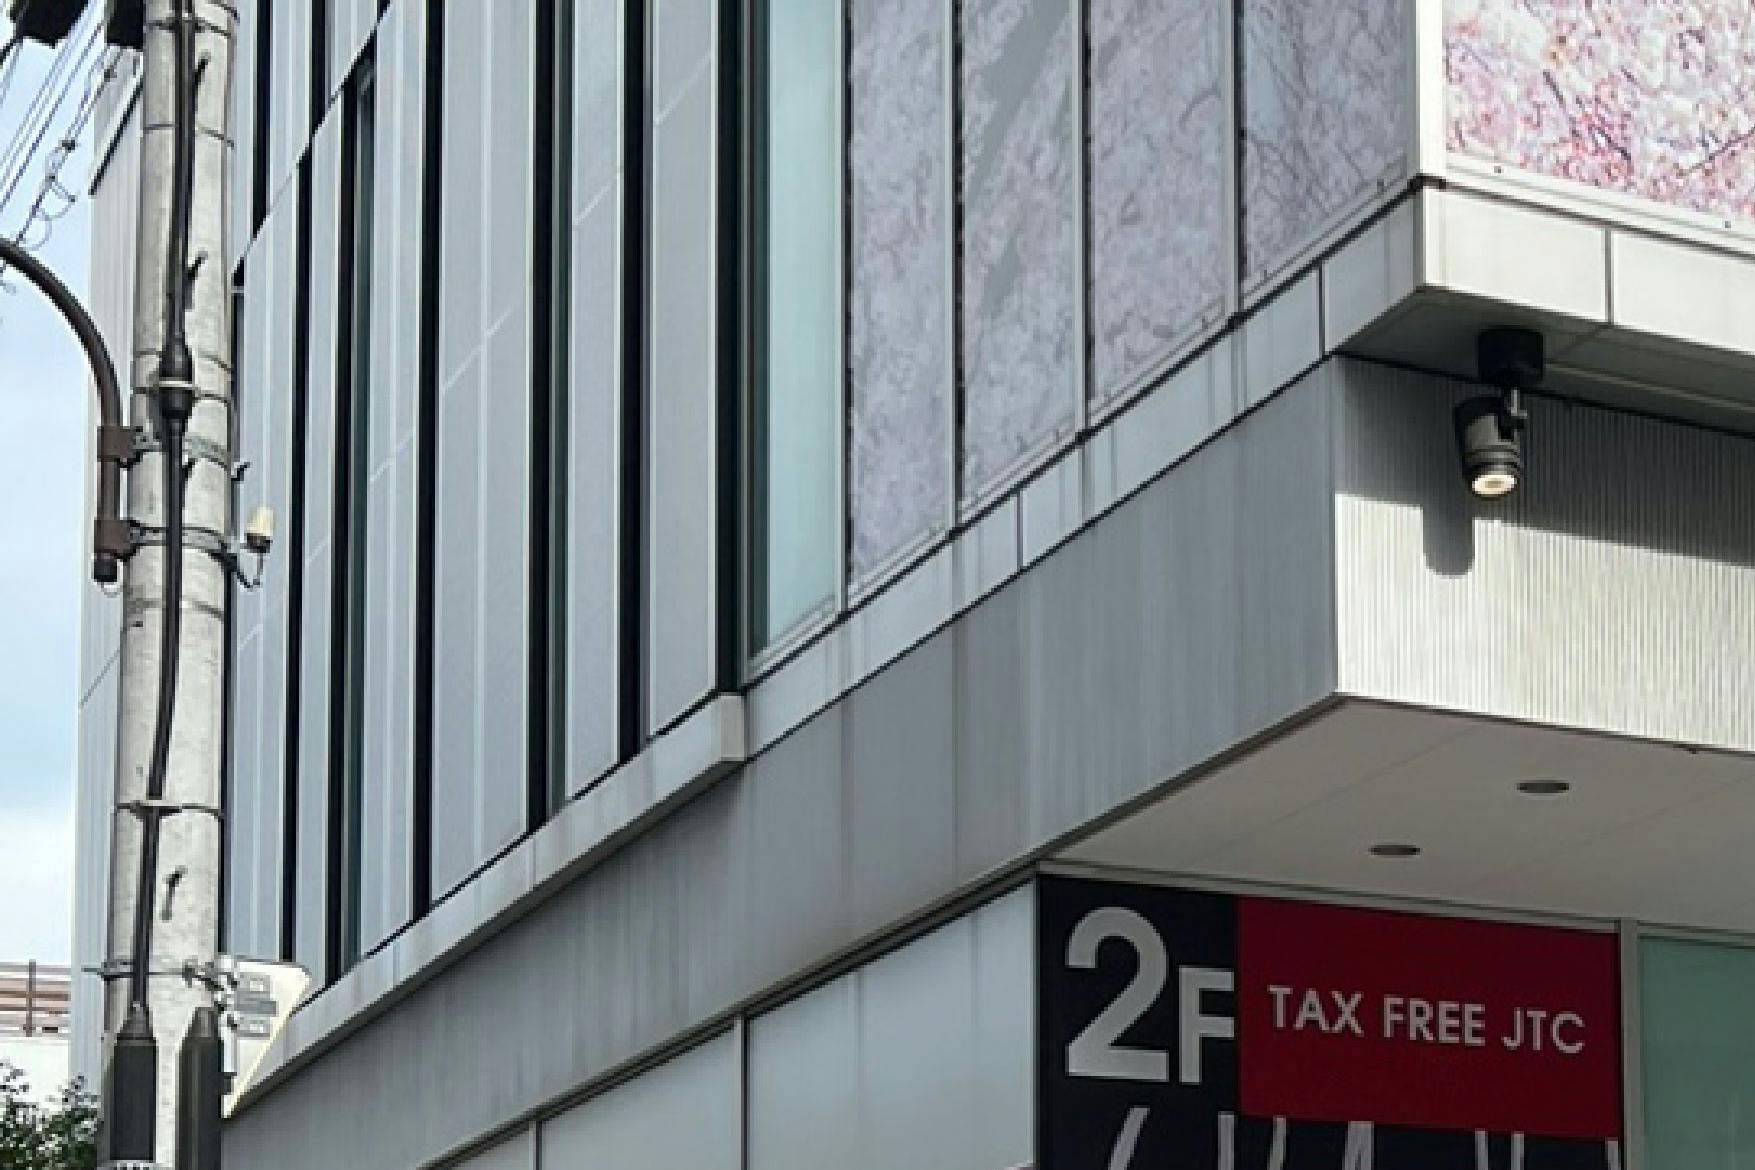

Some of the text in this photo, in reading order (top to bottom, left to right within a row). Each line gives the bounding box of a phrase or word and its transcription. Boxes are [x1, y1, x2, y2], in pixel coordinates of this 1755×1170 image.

[1065, 906, 1586, 1085] 2F TAX FREE JTC
